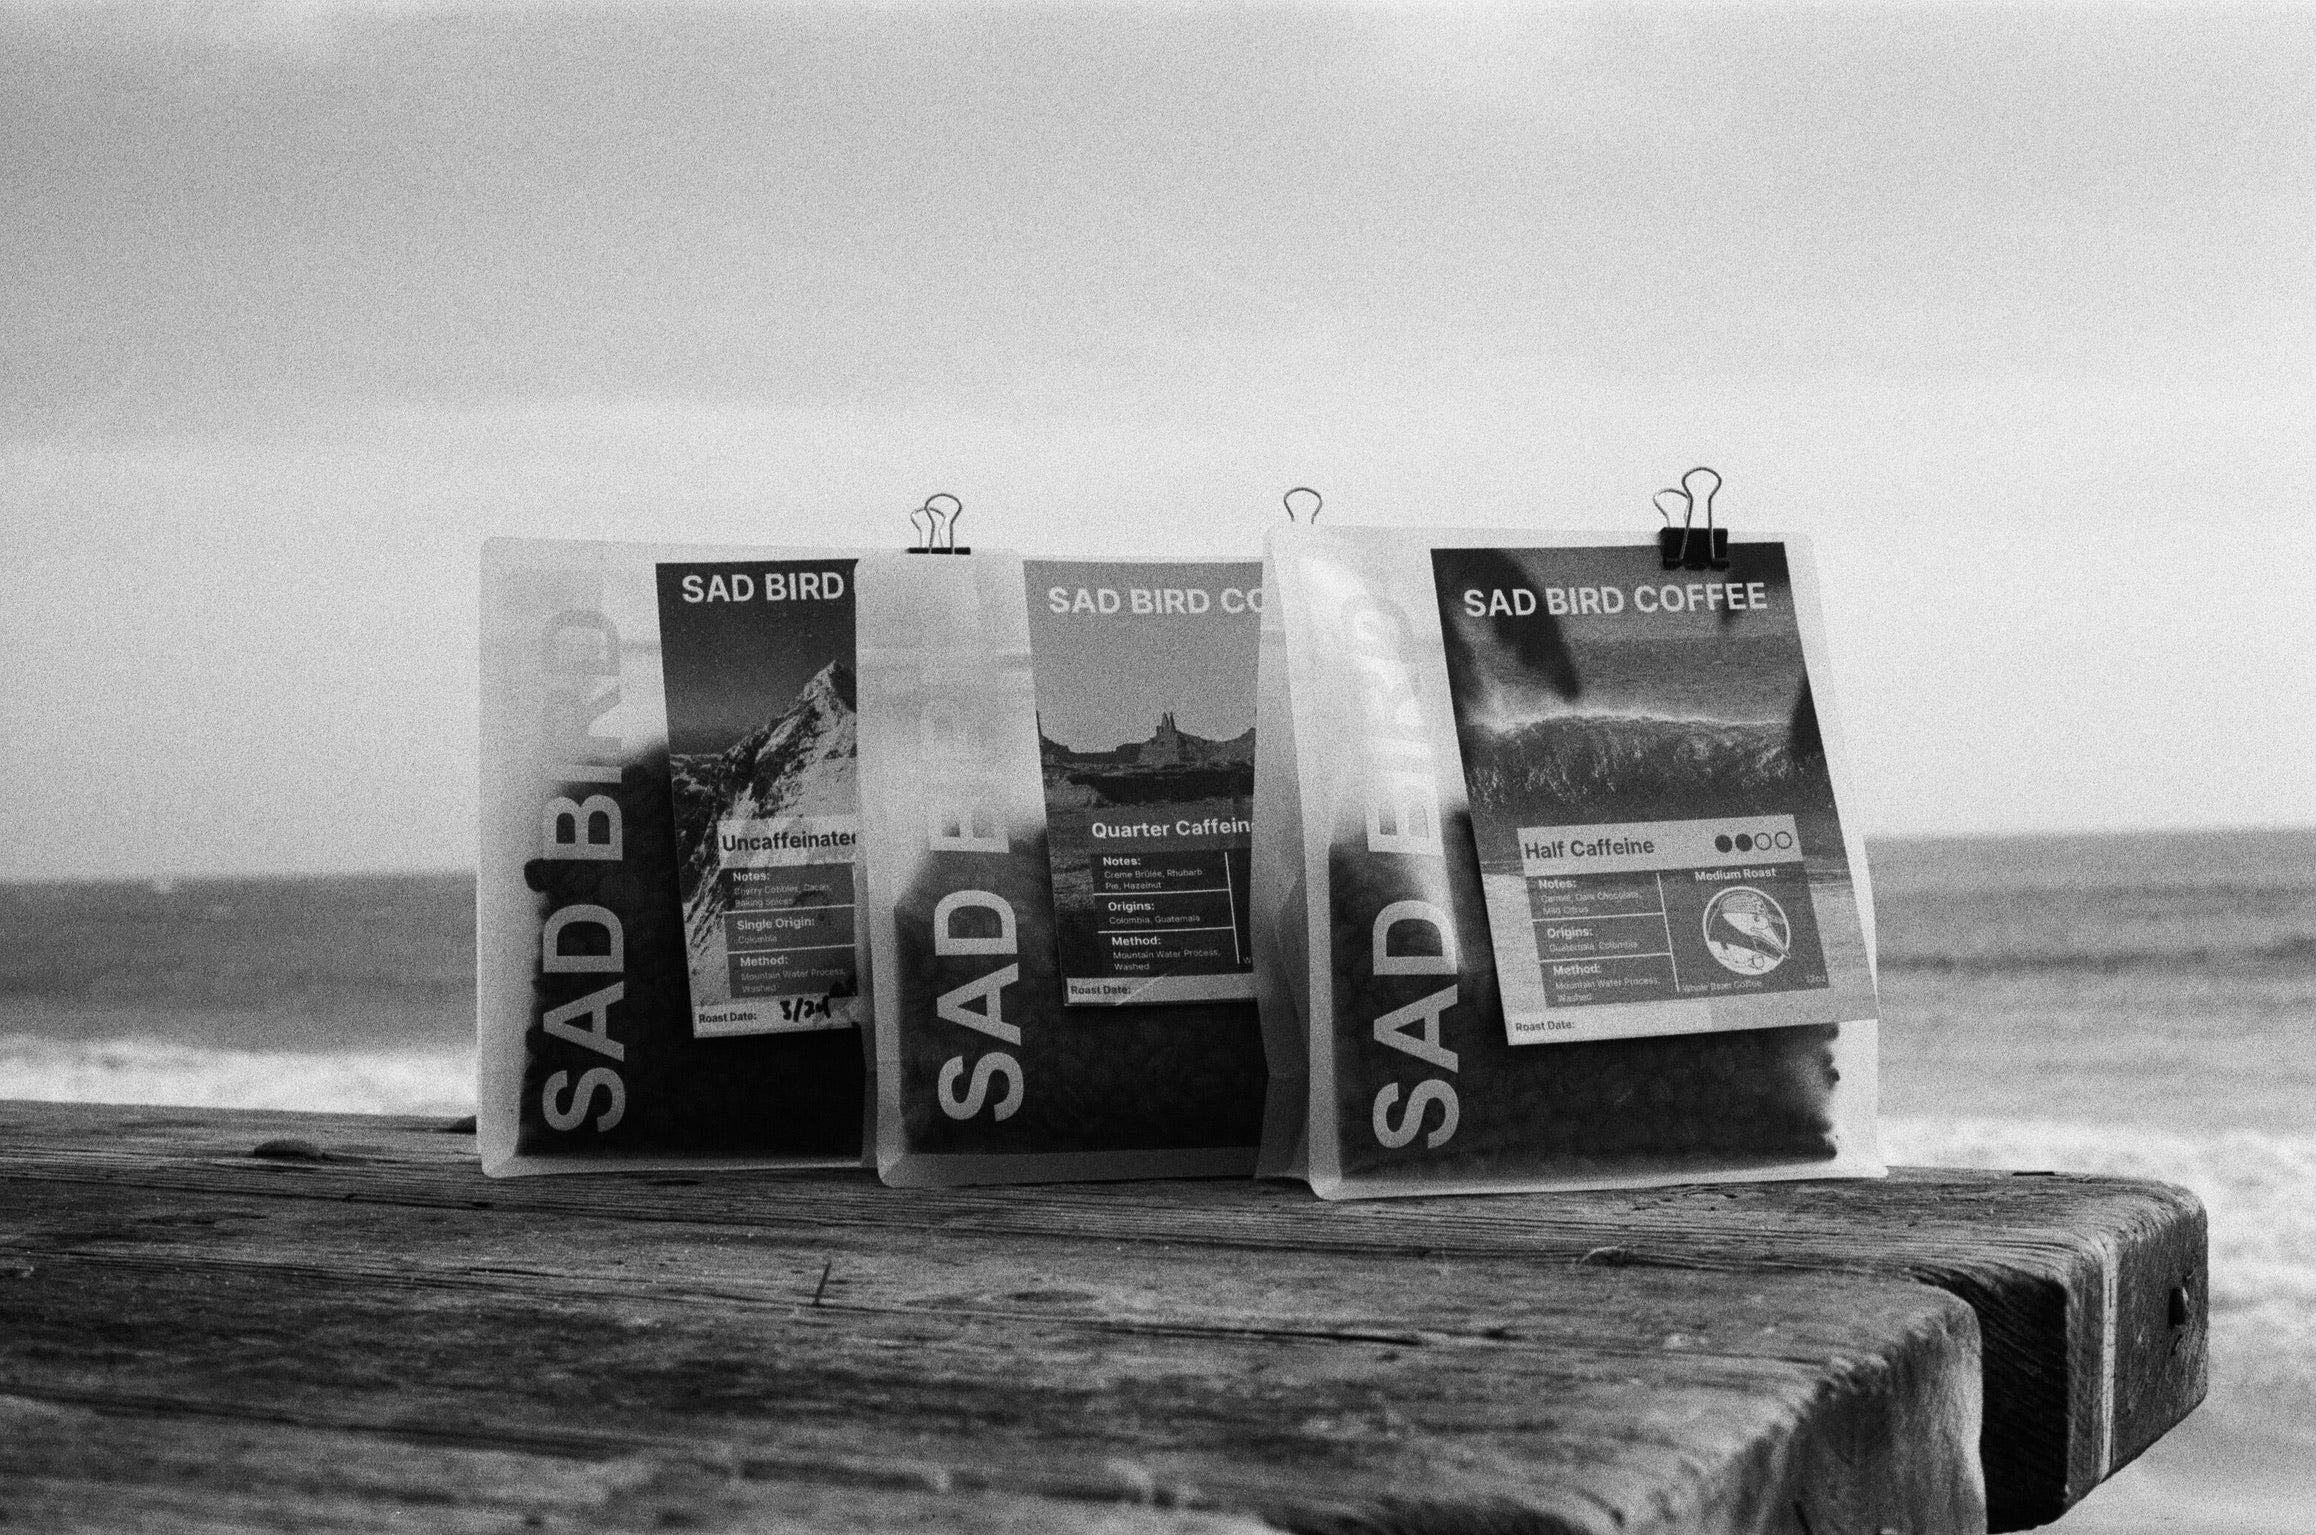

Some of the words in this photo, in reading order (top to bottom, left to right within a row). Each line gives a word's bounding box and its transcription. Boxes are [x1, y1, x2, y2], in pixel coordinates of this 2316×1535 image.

[681, 574, 755, 603] SAD
[765, 571, 845, 600] BIRD
[1049, 586, 1122, 614] SAD
[1129, 588, 1211, 614] BIRD
[1463, 588, 1537, 617] SAD
[1545, 585, 1625, 616] BIRD
[1634, 581, 1768, 613] COFFEE
[1091, 822, 1170, 839] Quarter
[1175, 817, 1253, 836] Caffein
[1525, 840, 1564, 859] Half
[1570, 838, 1655, 857] Caffeine
[1103, 856, 1141, 866] Notes:
[732, 872, 770, 882] Notes:
[1167, 869, 1203, 877] Rhubarb
[1695, 870, 1742, 881] Medium
[1743, 867, 1776, 878] Roast
[1105, 882, 1122, 891] Pie,
[1123, 882, 1162, 890] Hazelnut
[1538, 879, 1577, 889] Notes:
[734, 886, 763, 896] Cherry
[1108, 902, 1155, 913] Origins:
[736, 918, 773, 931] Single
[775, 916, 815, 930] Origin:
[1109, 916, 1151, 926] Colombia,
[1154, 914, 1201, 923] Guatemala
[1547, 928, 1593, 940] Origins:
[1111, 936, 1161, 946] Method:
[1600, 941, 1638, 949] Colombia
[740, 955, 789, 967] Method:
[1113, 951, 1154, 960] Mountain
[1156, 950, 1181, 958] Water
[1114, 963, 1150, 971] Washed
[1553, 964, 1601, 976] Method:
[741, 971, 781, 981] Mountain
[783, 969, 809, 978] Water
[742, 984, 778, 993] Washed
[1070, 986, 1101, 995] Roast
[1104, 985, 1131, 994] Date:
[1556, 981, 1596, 991] Mountain
[1598, 979, 1622, 988] Water
[933, 889, 1025, 1122] SAD
[541, 903, 626, 1132] SAD
[698, 1013, 728, 1024] Roast
[730, 1011, 757, 1021] Date:
[1372, 900, 1460, 1149] SAD
[1515, 1021, 1546, 1032] Roast
[1548, 1020, 1575, 1030] Date:
